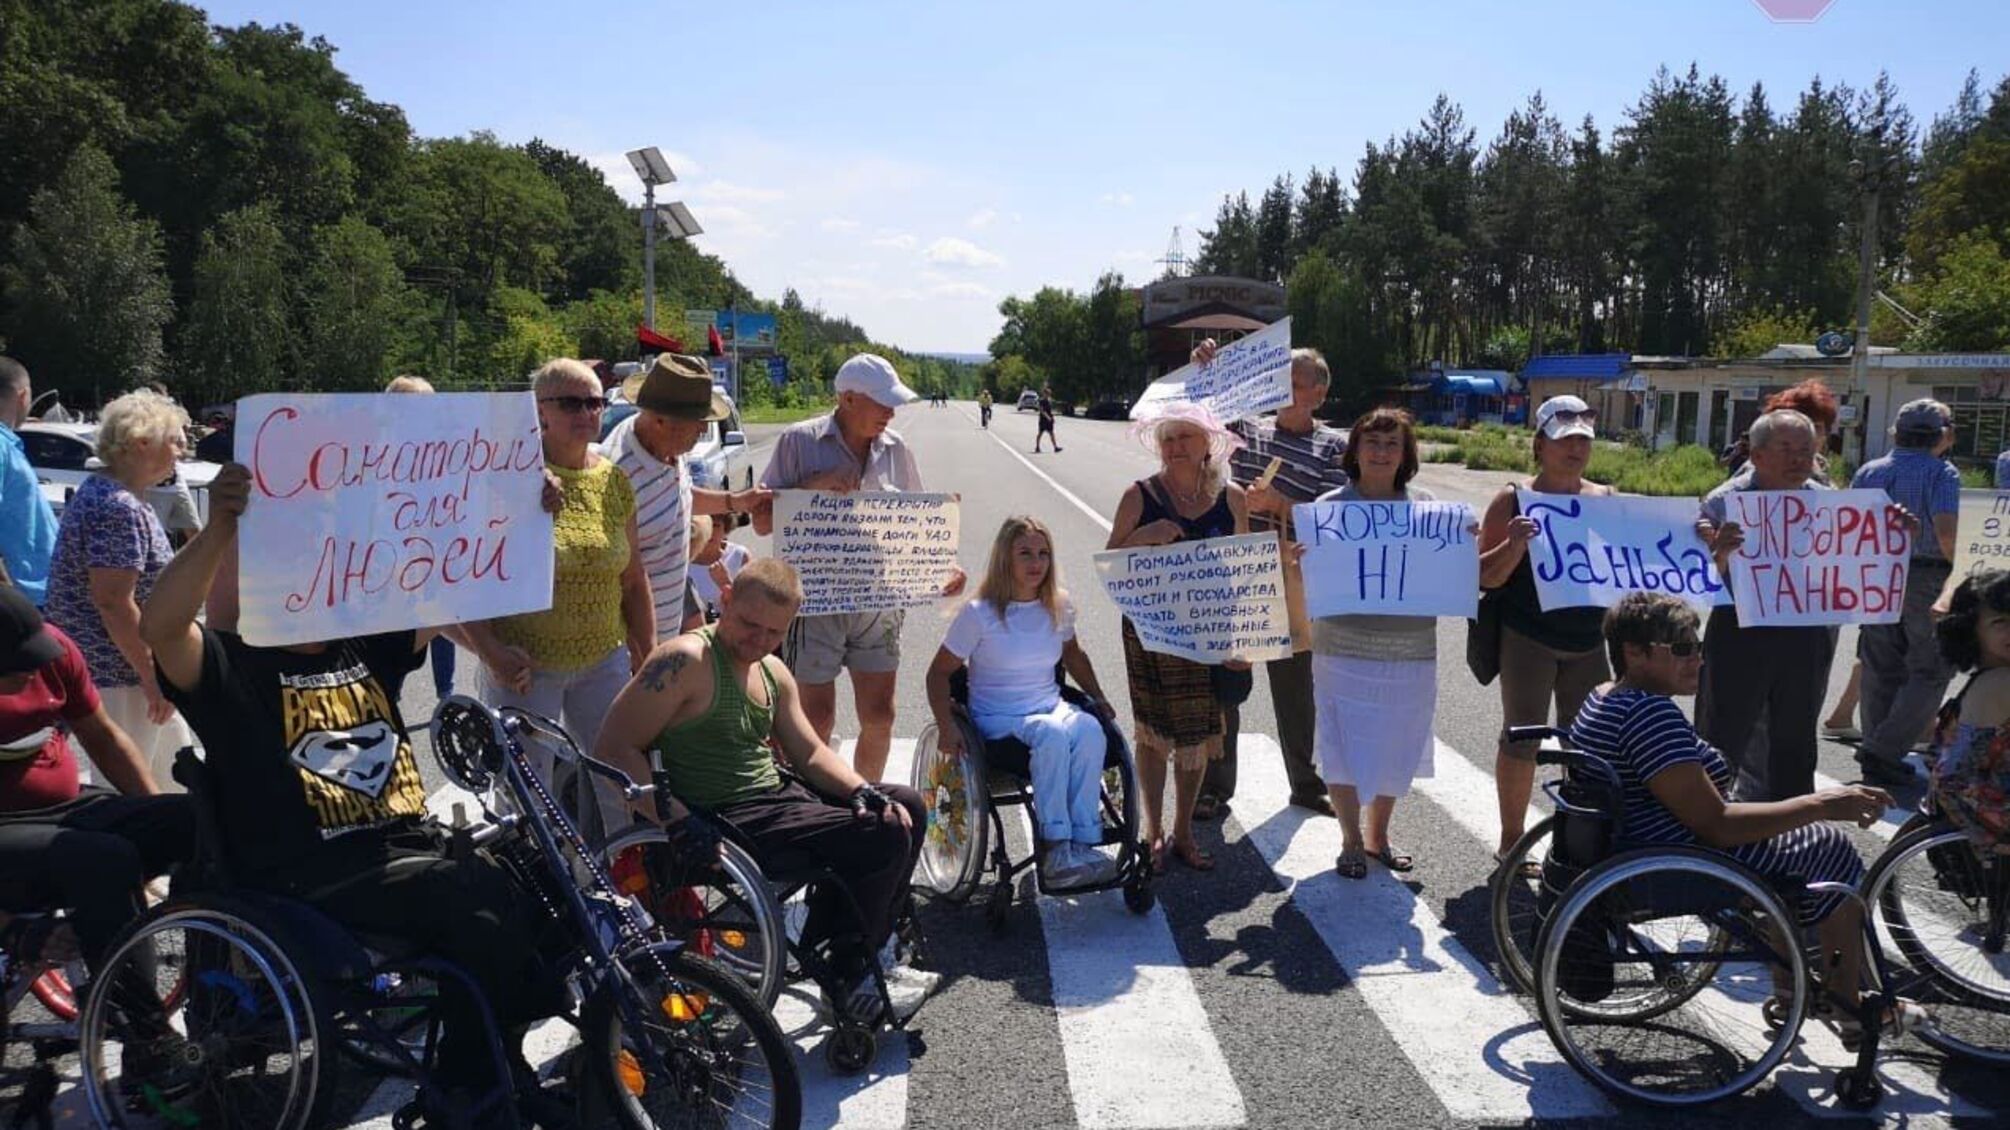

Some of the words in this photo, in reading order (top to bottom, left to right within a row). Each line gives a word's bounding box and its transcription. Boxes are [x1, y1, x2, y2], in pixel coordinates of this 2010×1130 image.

[1187, 284, 1251, 302] PICNIC
[254, 407, 543, 500] Санаторий
[387, 491, 467, 531] для
[793, 511, 838, 523] ДОРОГИ
[882, 531, 918, 542] ДОЛГИ
[1525, 498, 1723, 595] Ганьба
[1107, 576, 1160, 591] ПРОСИТ
[1169, 561, 1278, 584] РУКОВОДИТЕЛЕЙ
[1356, 544, 1408, 601] НІ
[1750, 562, 1905, 618] ГАНЬБА
[1172, 589, 1181, 604] И
[1187, 583, 1277, 602] ГОСУДАРСТВА
[1189, 604, 1271, 619] ВИНОВНЫХ
[281, 675, 398, 751] BATMAN
